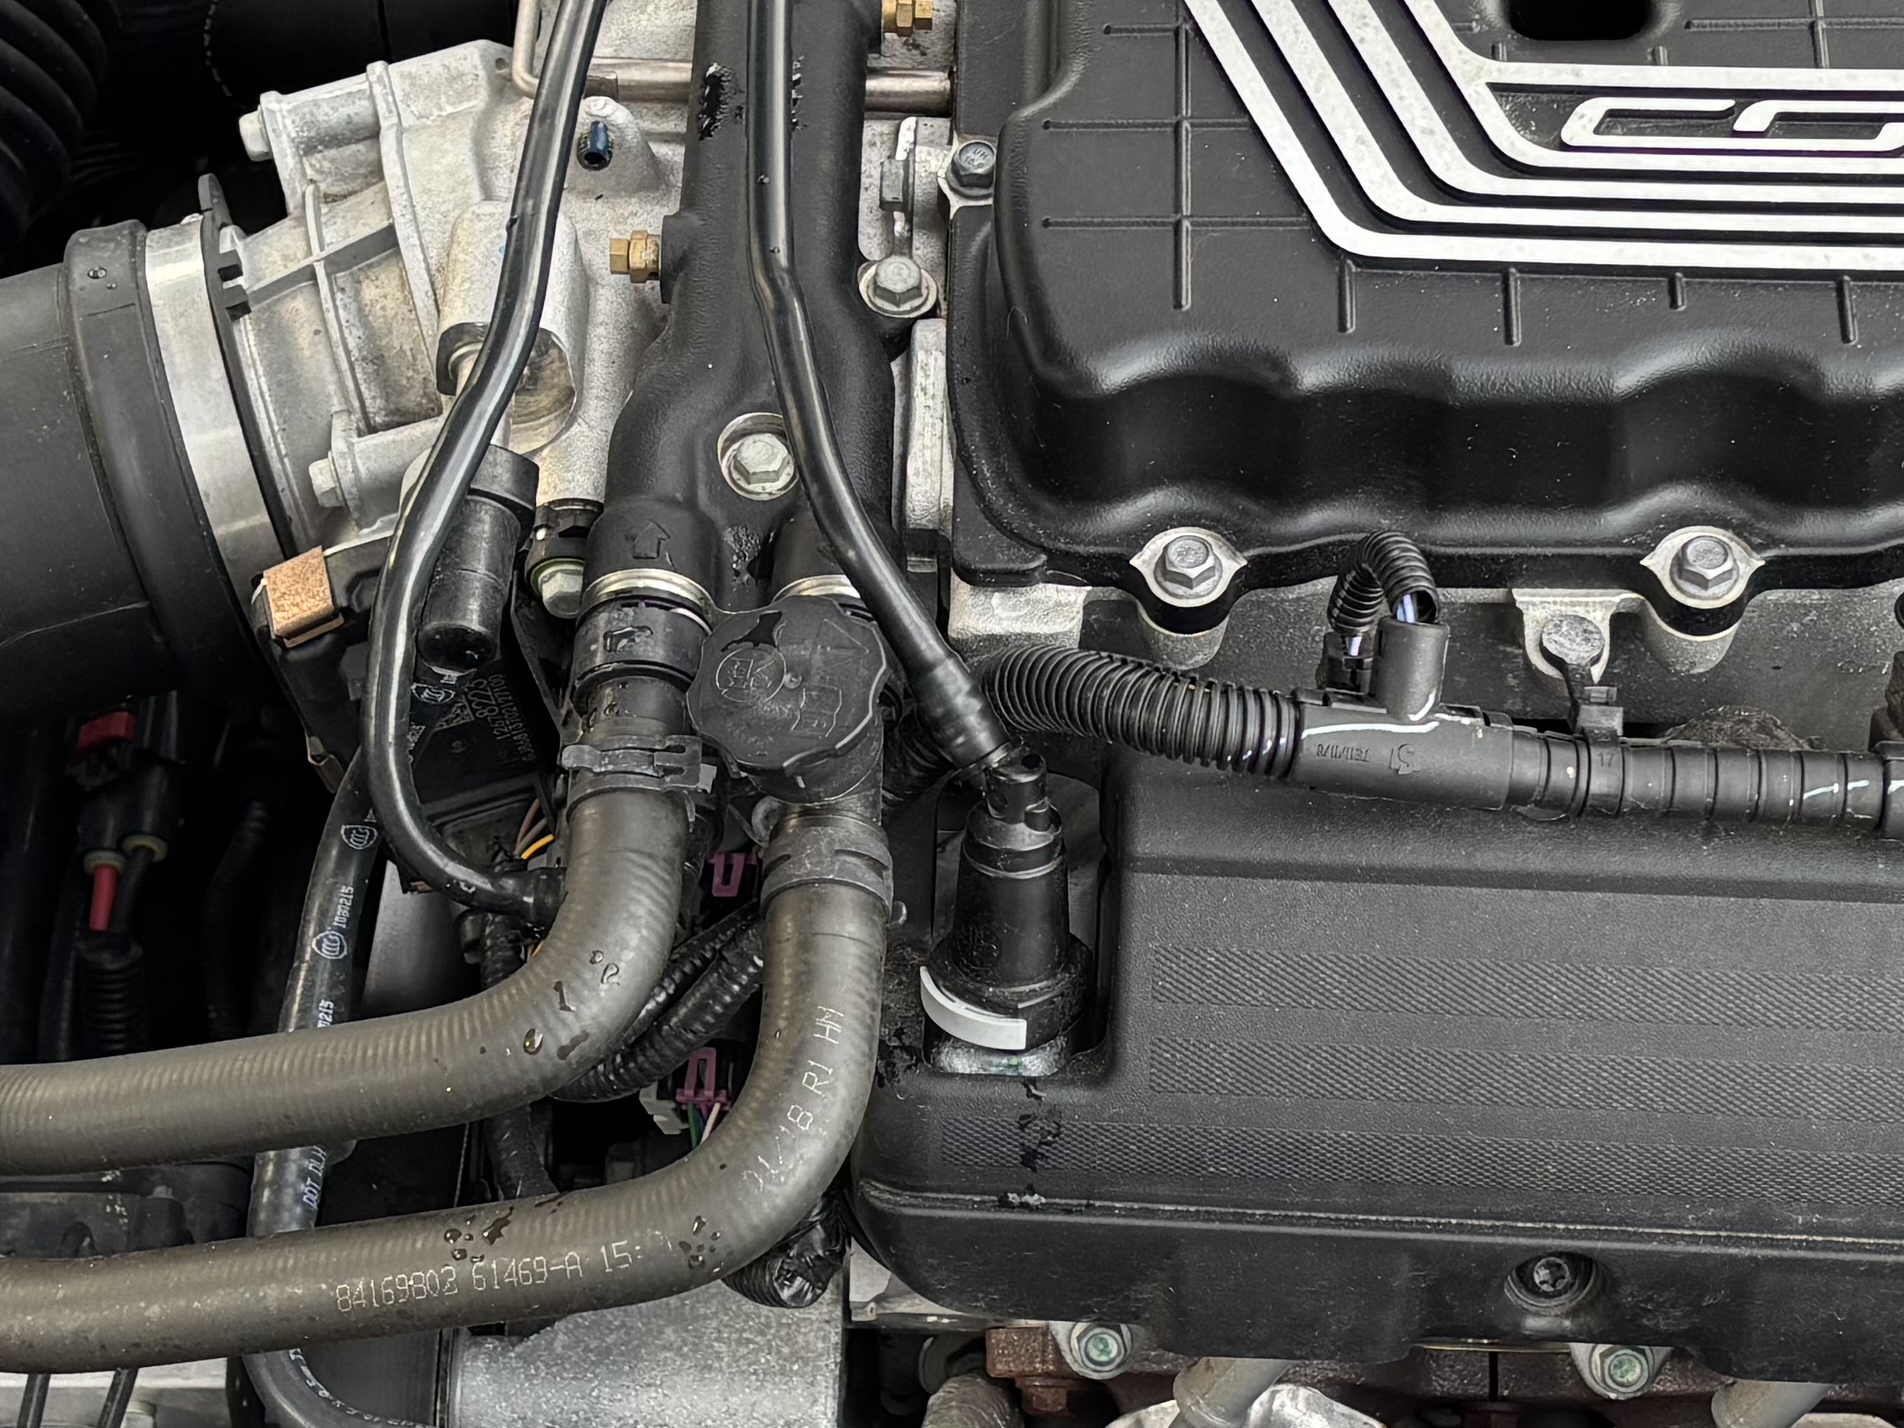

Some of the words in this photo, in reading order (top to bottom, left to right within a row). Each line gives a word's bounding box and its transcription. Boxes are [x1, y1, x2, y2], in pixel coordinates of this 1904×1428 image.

[335, 1260, 459, 1318] 84169802
[470, 1244, 586, 1296] 61469-A
[798, 1055, 836, 1099] R1
